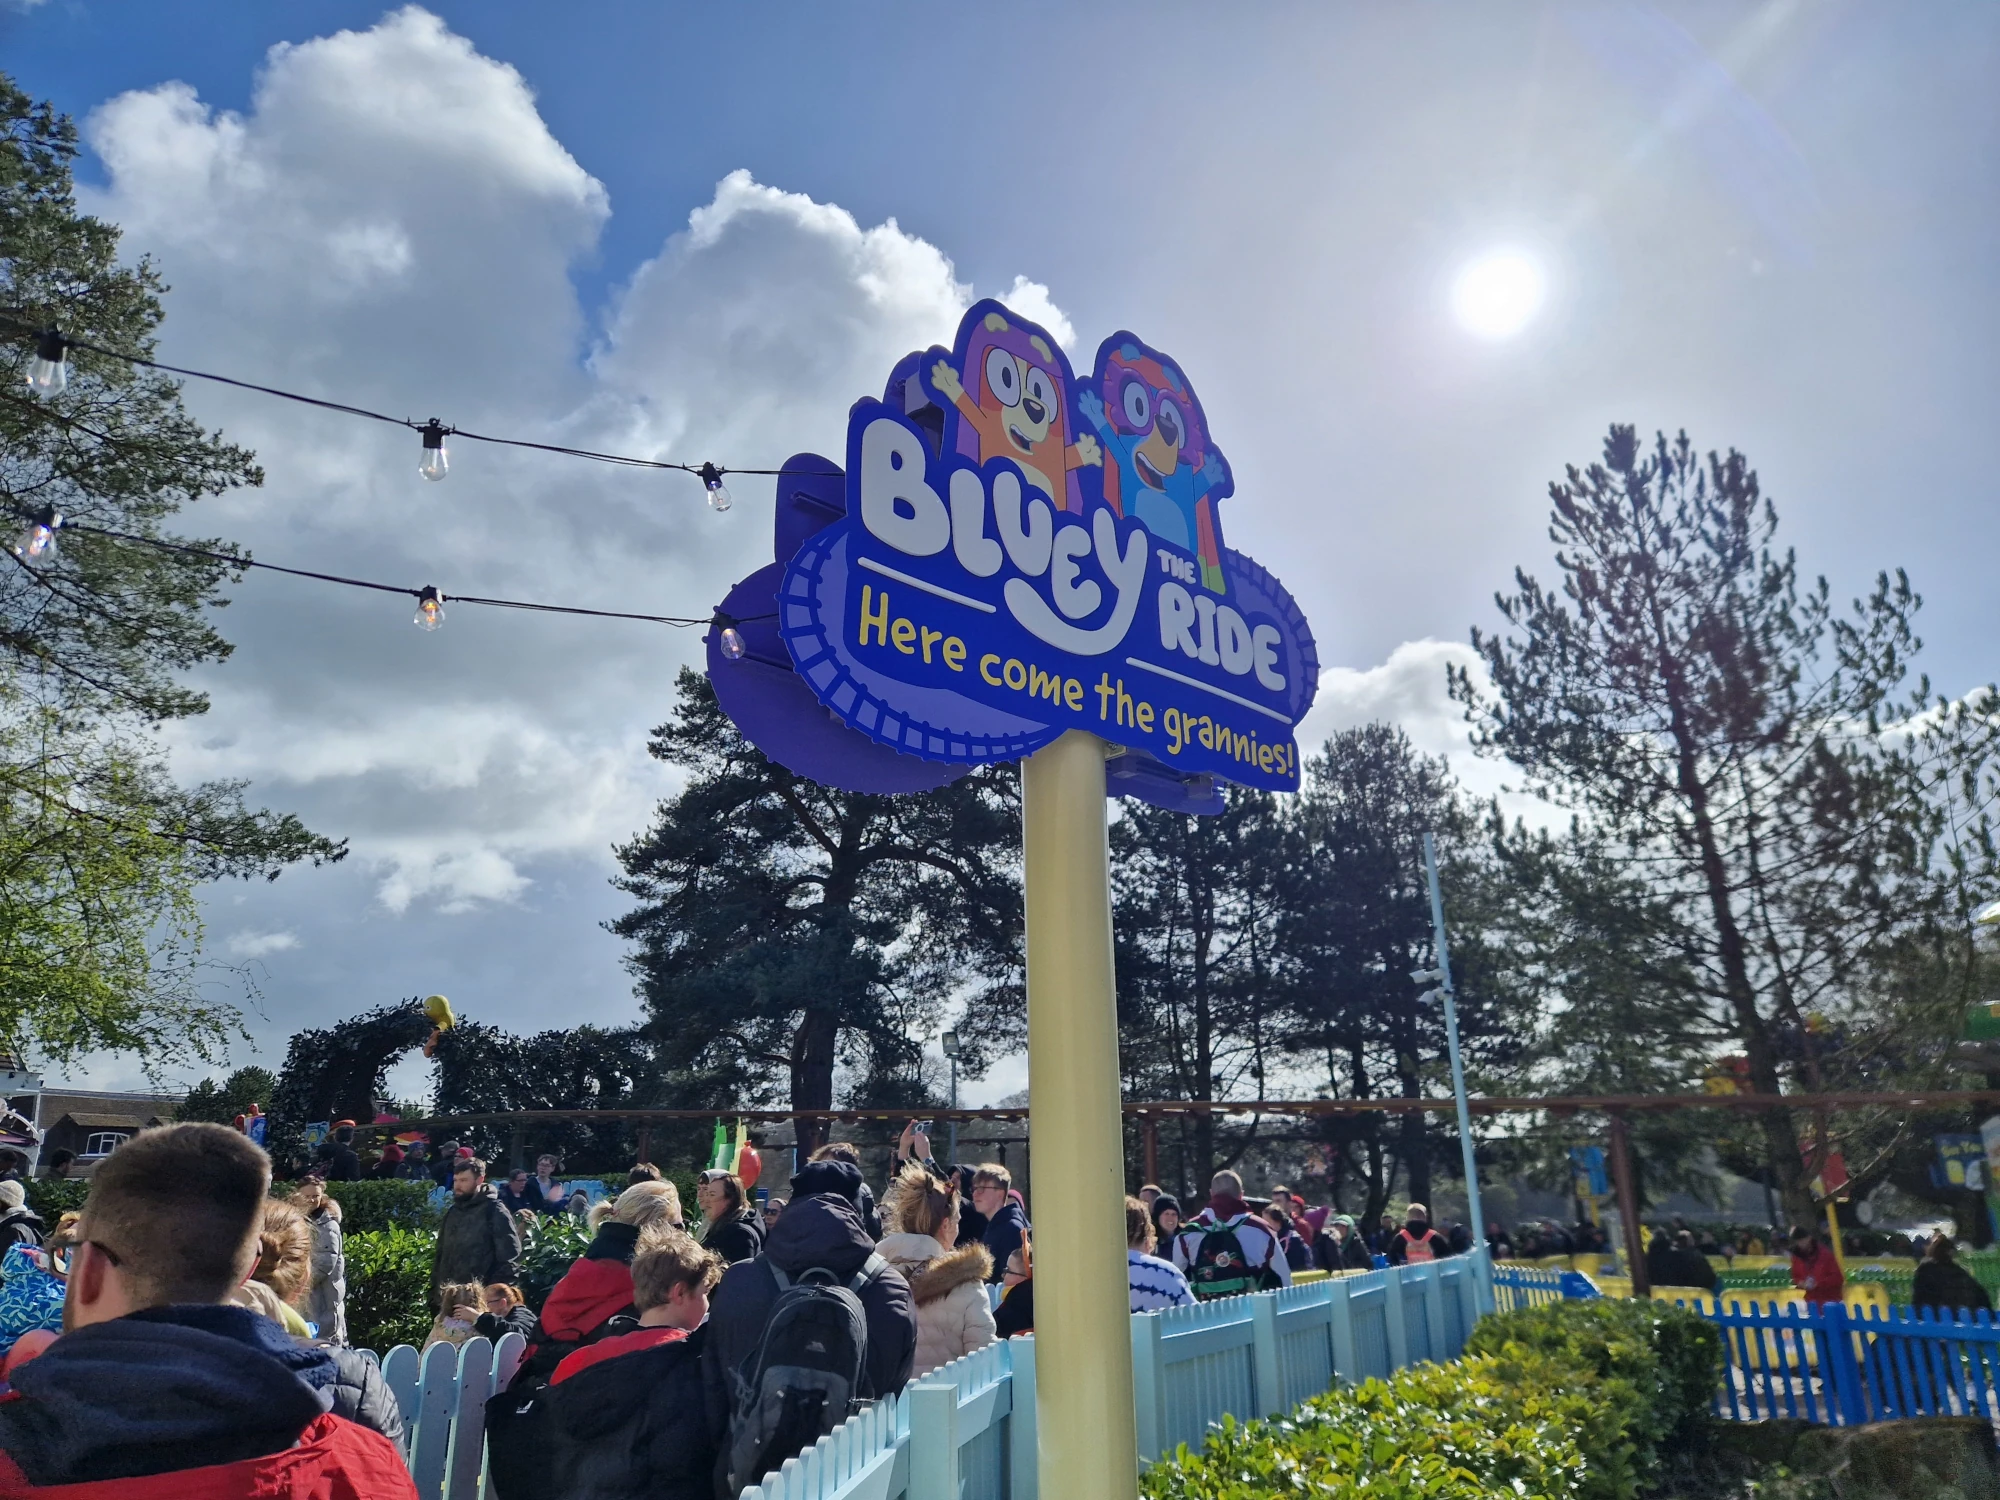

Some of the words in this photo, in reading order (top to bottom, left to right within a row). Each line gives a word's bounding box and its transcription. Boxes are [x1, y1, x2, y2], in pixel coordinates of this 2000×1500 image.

[1157, 549, 1196, 584] THE
[858, 585, 967, 672] Here
[979, 654, 1084, 712] come
[1094, 672, 1155, 734] the
[1163, 708, 1296, 779] grannies!
[1158, 583, 1286, 691] RIDE
